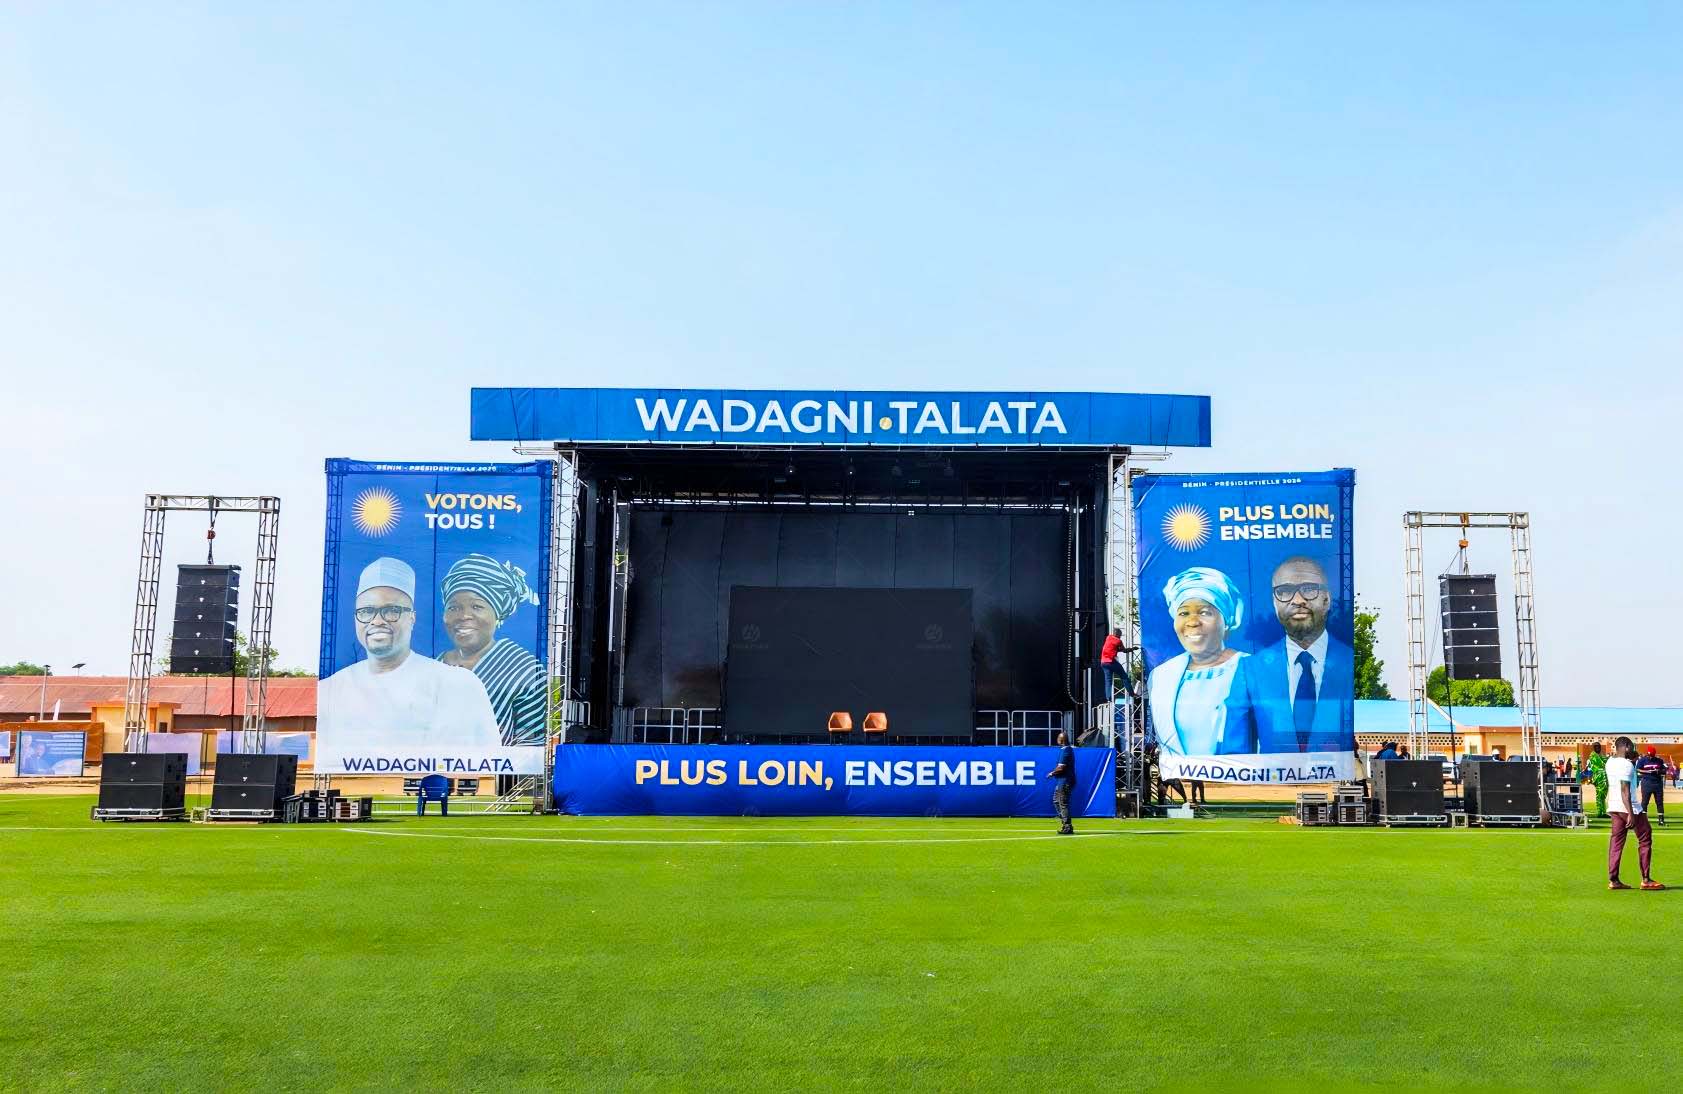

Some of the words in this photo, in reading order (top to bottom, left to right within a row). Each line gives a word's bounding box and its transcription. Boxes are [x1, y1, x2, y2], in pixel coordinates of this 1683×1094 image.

[634, 398, 873, 433] WADAGNI
[888, 401, 1068, 434] TALATA
[425, 493, 522, 513] VOTONS,
[425, 513, 483, 530] TOUS
[1220, 505, 1274, 521] PLUS
[1280, 504, 1335, 522] LOIN,
[1220, 524, 1333, 540] ENSEMBLE
[343, 758, 436, 772] WADAGNI
[445, 758, 514, 772] TALATA
[1179, 764, 1270, 782] WADAGNI
[1276, 766, 1336, 782] TALATA
[635, 760, 728, 785] PLUS
[738, 760, 834, 791] LOIN,
[845, 760, 1036, 786] ENSEMBLE
